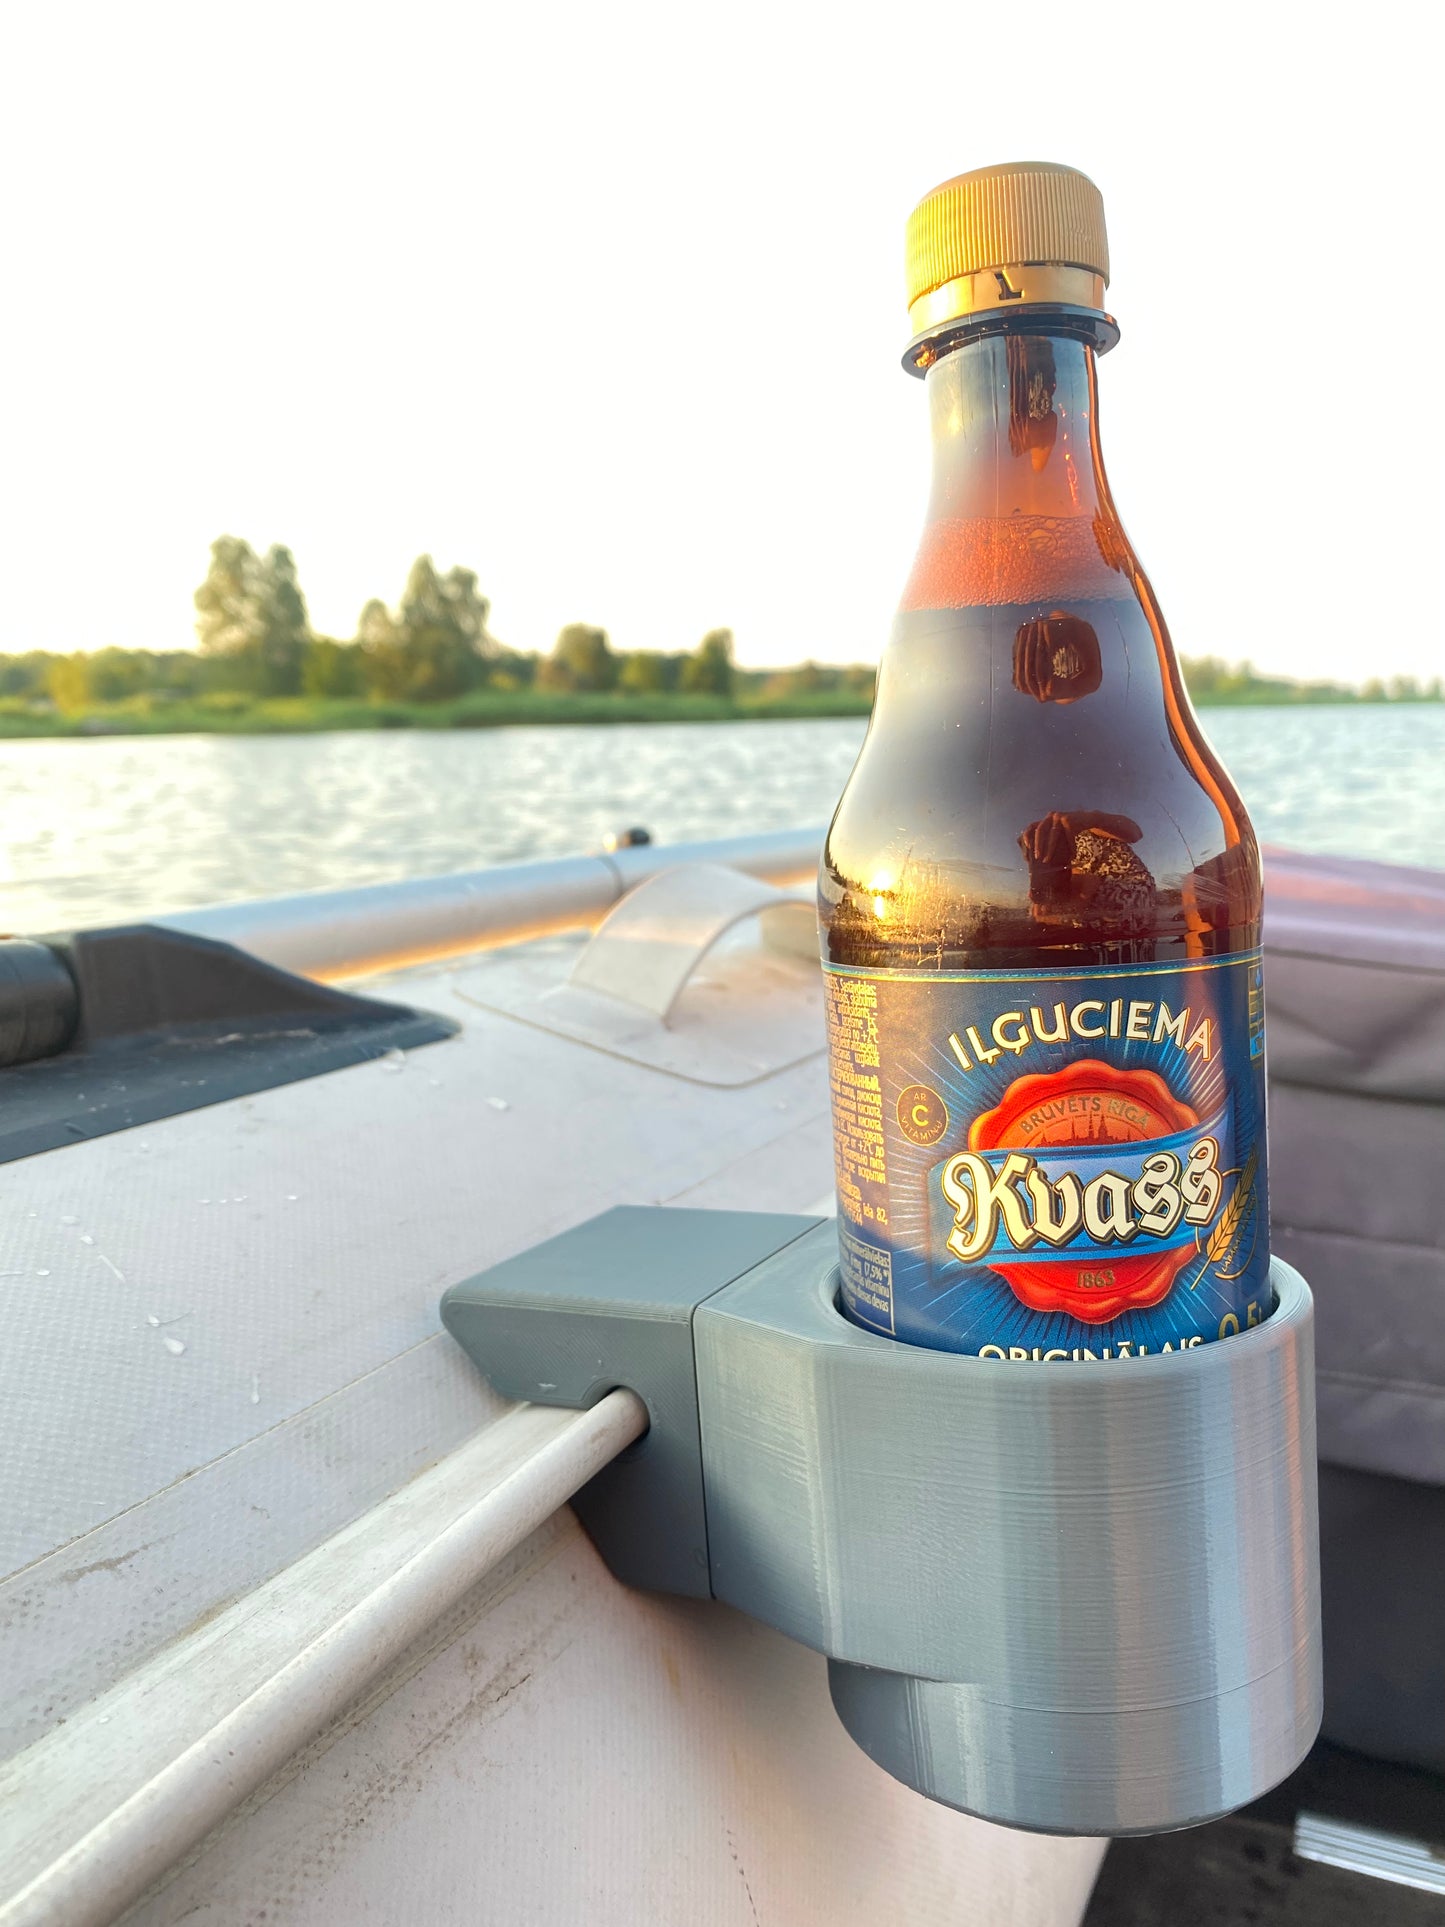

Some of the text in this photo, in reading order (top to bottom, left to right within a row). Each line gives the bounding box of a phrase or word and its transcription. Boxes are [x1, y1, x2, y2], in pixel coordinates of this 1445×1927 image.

[914, 1092, 927, 1101] AR
[912, 1105, 928, 1126] C
[942, 1137, 1223, 1262] Kvass
[1077, 1270, 1115, 1288] 1863
